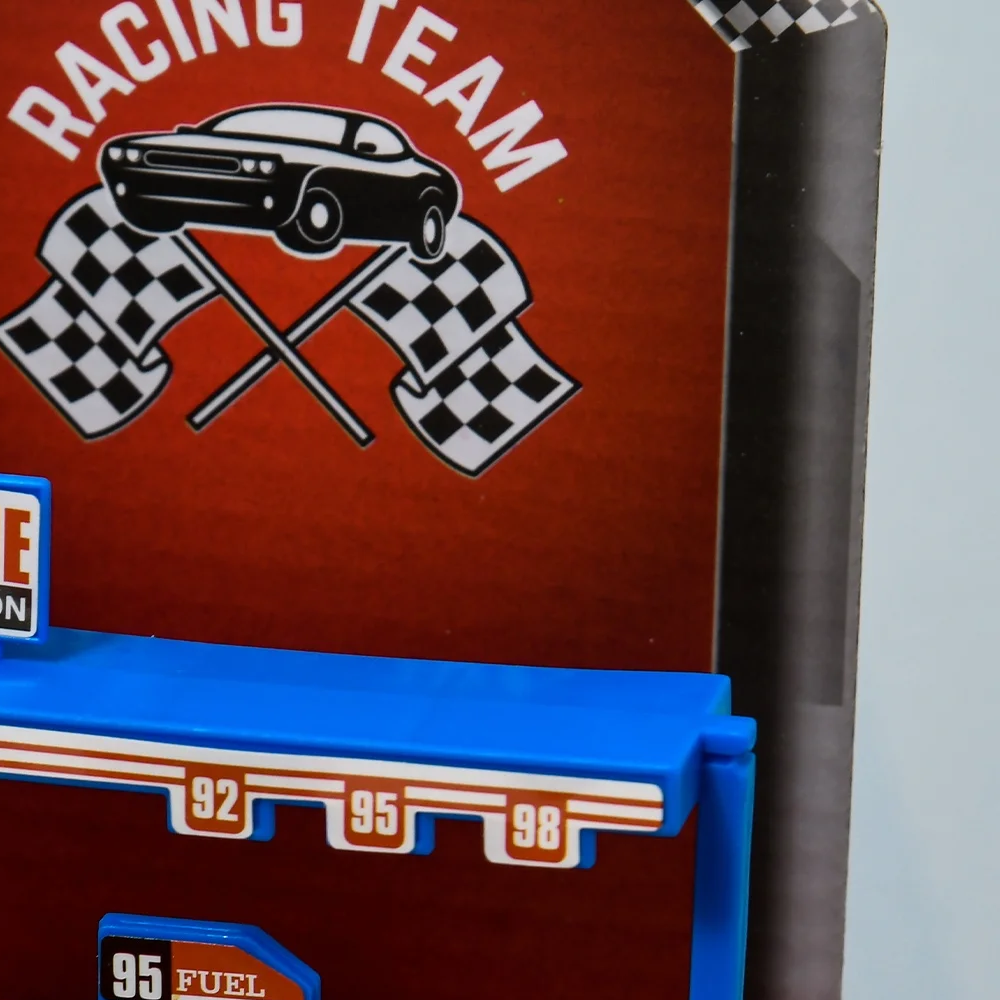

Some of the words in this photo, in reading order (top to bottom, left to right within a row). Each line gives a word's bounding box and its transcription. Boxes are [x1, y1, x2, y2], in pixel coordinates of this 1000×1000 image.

[7, 0, 302, 162] RACING
[346, 0, 568, 192] TEAM
[191, 776, 239, 822] 92
[350, 790, 398, 836] 95
[512, 803, 561, 851] 98
[112, 952, 162, 1000] 95
[176, 968, 266, 998] FUEL
